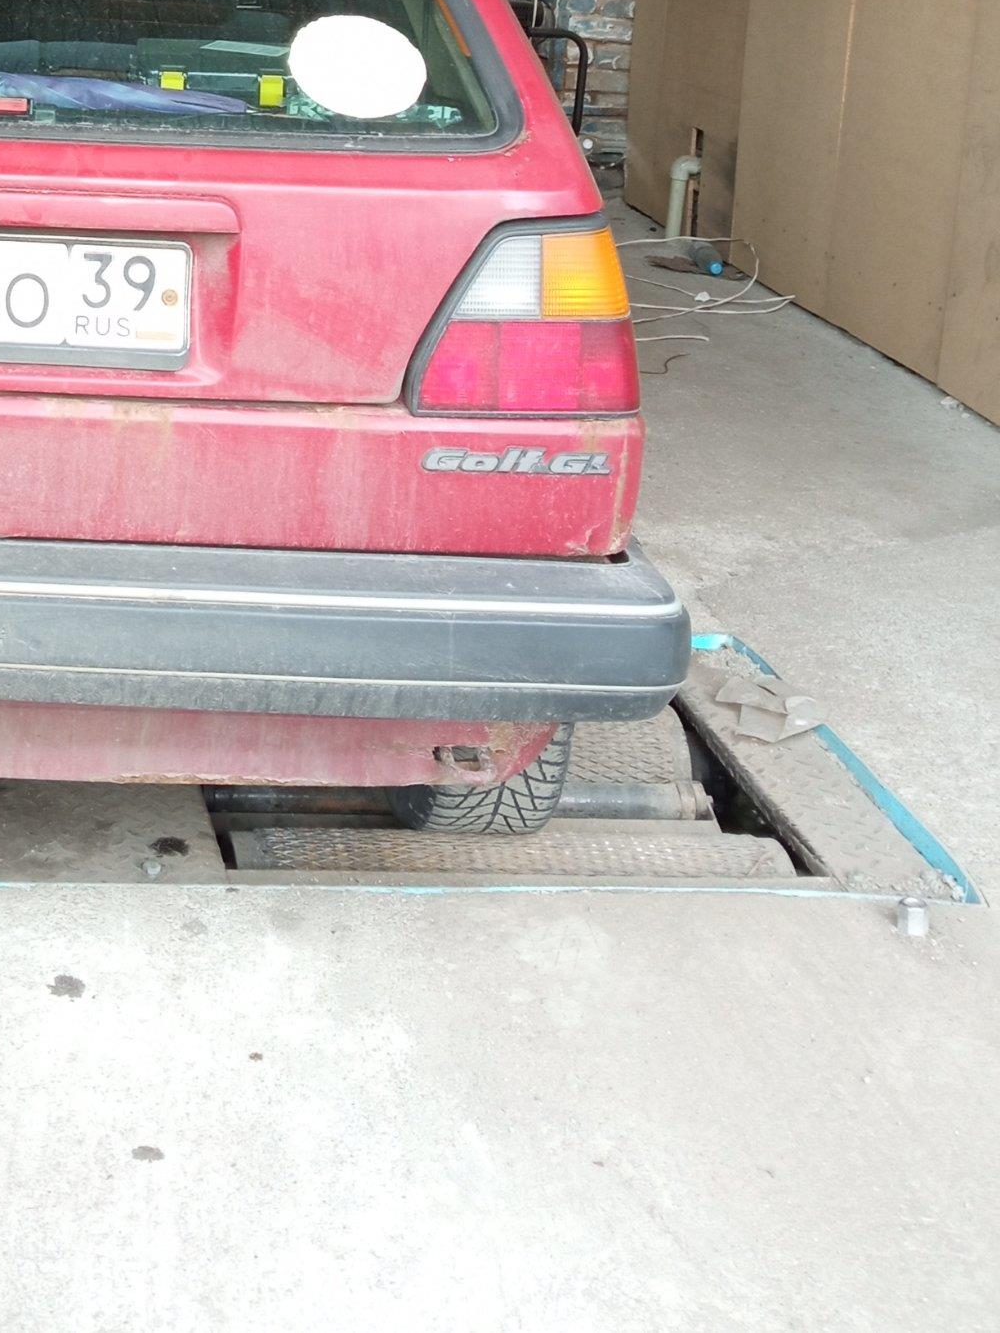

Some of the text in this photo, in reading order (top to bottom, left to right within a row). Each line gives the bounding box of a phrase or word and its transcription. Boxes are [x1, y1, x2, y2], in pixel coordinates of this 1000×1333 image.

[81, 253, 157, 311] 39
[74, 314, 130, 338] RUS
[421, 447, 546, 473] Golf
